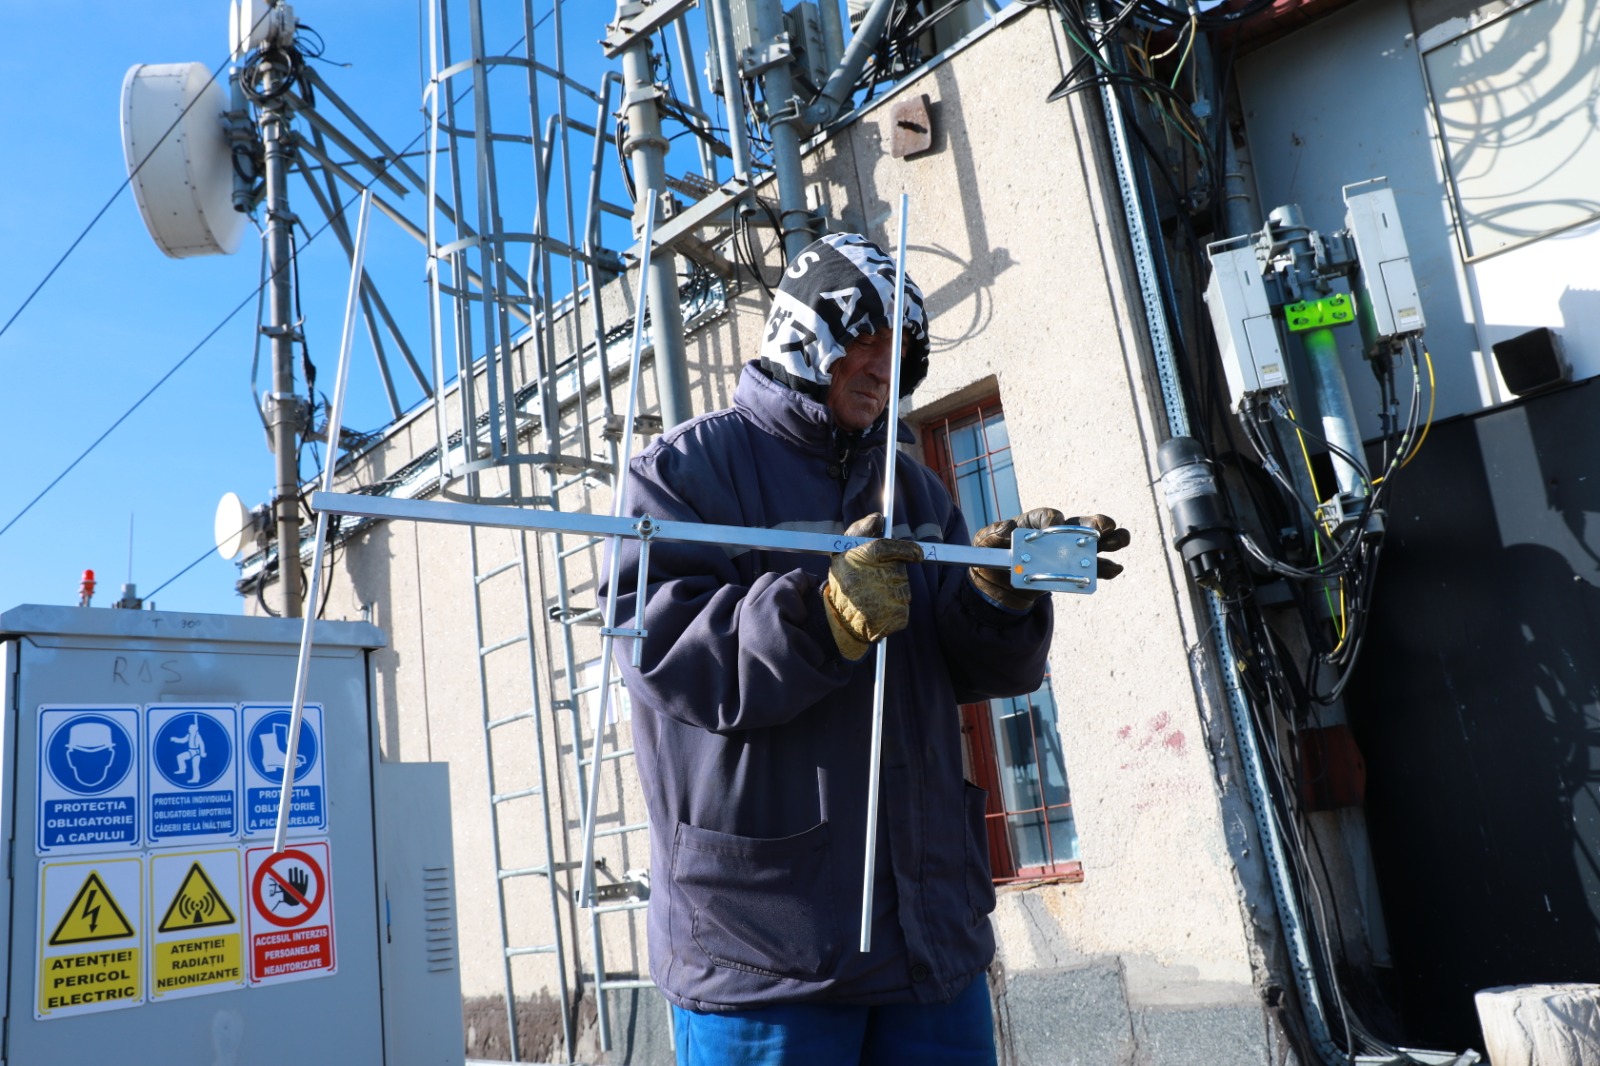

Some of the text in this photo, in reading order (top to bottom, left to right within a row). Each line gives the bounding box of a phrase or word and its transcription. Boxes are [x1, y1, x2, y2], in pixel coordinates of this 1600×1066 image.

[54, 801, 127, 813] PROTECȚIA
[154, 796, 191, 807] PROTECȚIA
[47, 815, 133, 828] OBLIGATORIE
[154, 809, 197, 819] OBLIGATORIE
[182, 822, 191, 831] DE
[192, 822, 201, 830] LA
[250, 819, 257, 828] A
[56, 831, 124, 843] A CAPULUI
[256, 928, 328, 946] ACCESUL INTERZIS
[171, 938, 225, 955] ATENȚIE!
[264, 944, 320, 960] PERSOANELOR
[51, 951, 132, 970] ATENȚIE!
[172, 954, 224, 970] RADIAȚII
[264, 958, 323, 976] NEAUTORIZATE
[53, 970, 131, 988] PERICOL
[157, 967, 239, 988] NEIONIZANTE
[48, 986, 135, 1008] ELECTRIC
